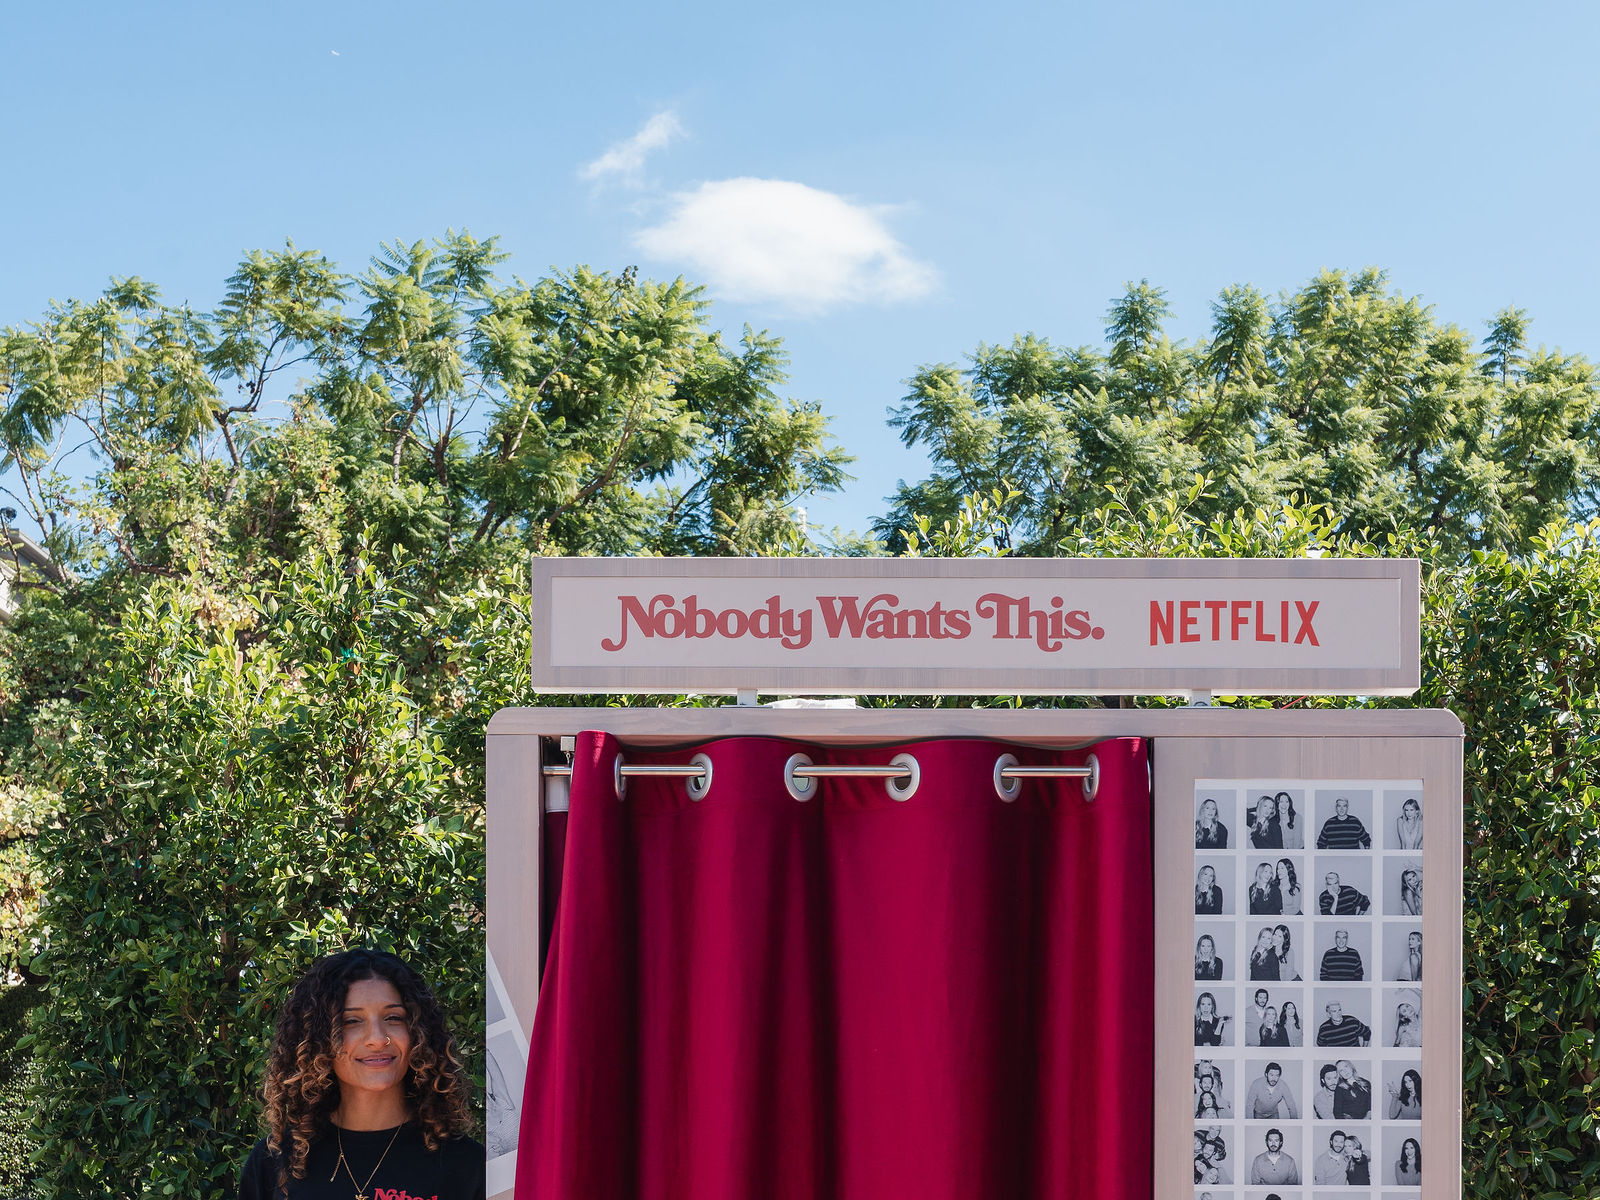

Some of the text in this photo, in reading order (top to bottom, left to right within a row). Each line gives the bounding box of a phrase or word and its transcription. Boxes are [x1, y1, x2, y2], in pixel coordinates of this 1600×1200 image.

[601, 593, 1105, 652] Nobody Wants This.
[1150, 600, 1321, 647] NETFLIX
